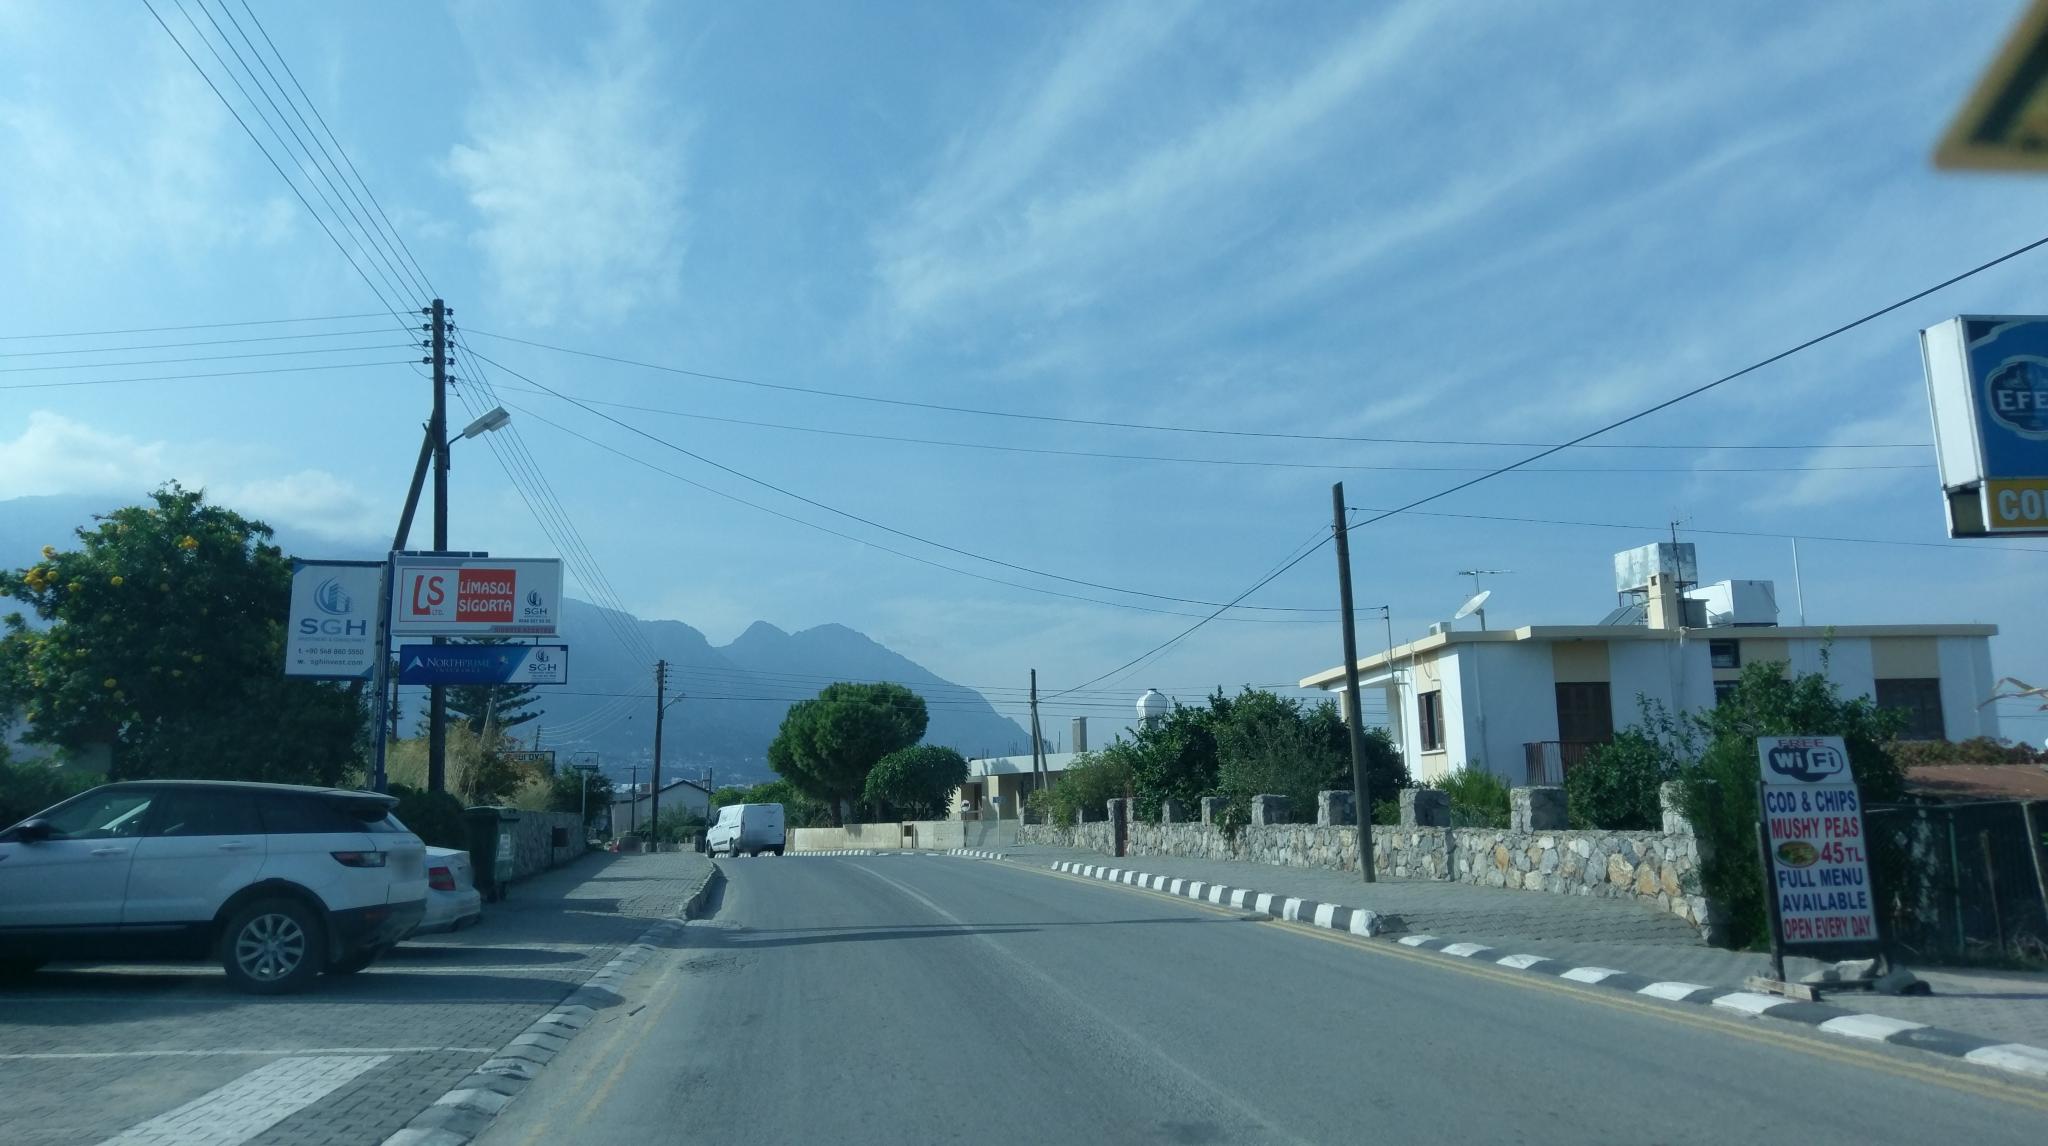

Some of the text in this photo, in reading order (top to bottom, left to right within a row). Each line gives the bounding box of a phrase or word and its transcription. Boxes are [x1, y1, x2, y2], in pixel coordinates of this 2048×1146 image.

[1999, 489, 2048, 521] CO
[459, 578, 513, 595] LİMASOL
[458, 597, 513, 613] SİGORTA
[524, 607, 547, 615] SGH
[299, 618, 367, 636] SGH
[528, 663, 557, 671] SGH
[1776, 739, 1824, 748] FREE
[1767, 790, 1857, 813] COD & CHIPS
[1771, 817, 1859, 839] MUSHY PEAS
[1778, 868, 1863, 888] FULL MENU
[1782, 891, 1867, 912] AVAILABLE
[1784, 915, 1871, 940] OPEN EVERY DAY
